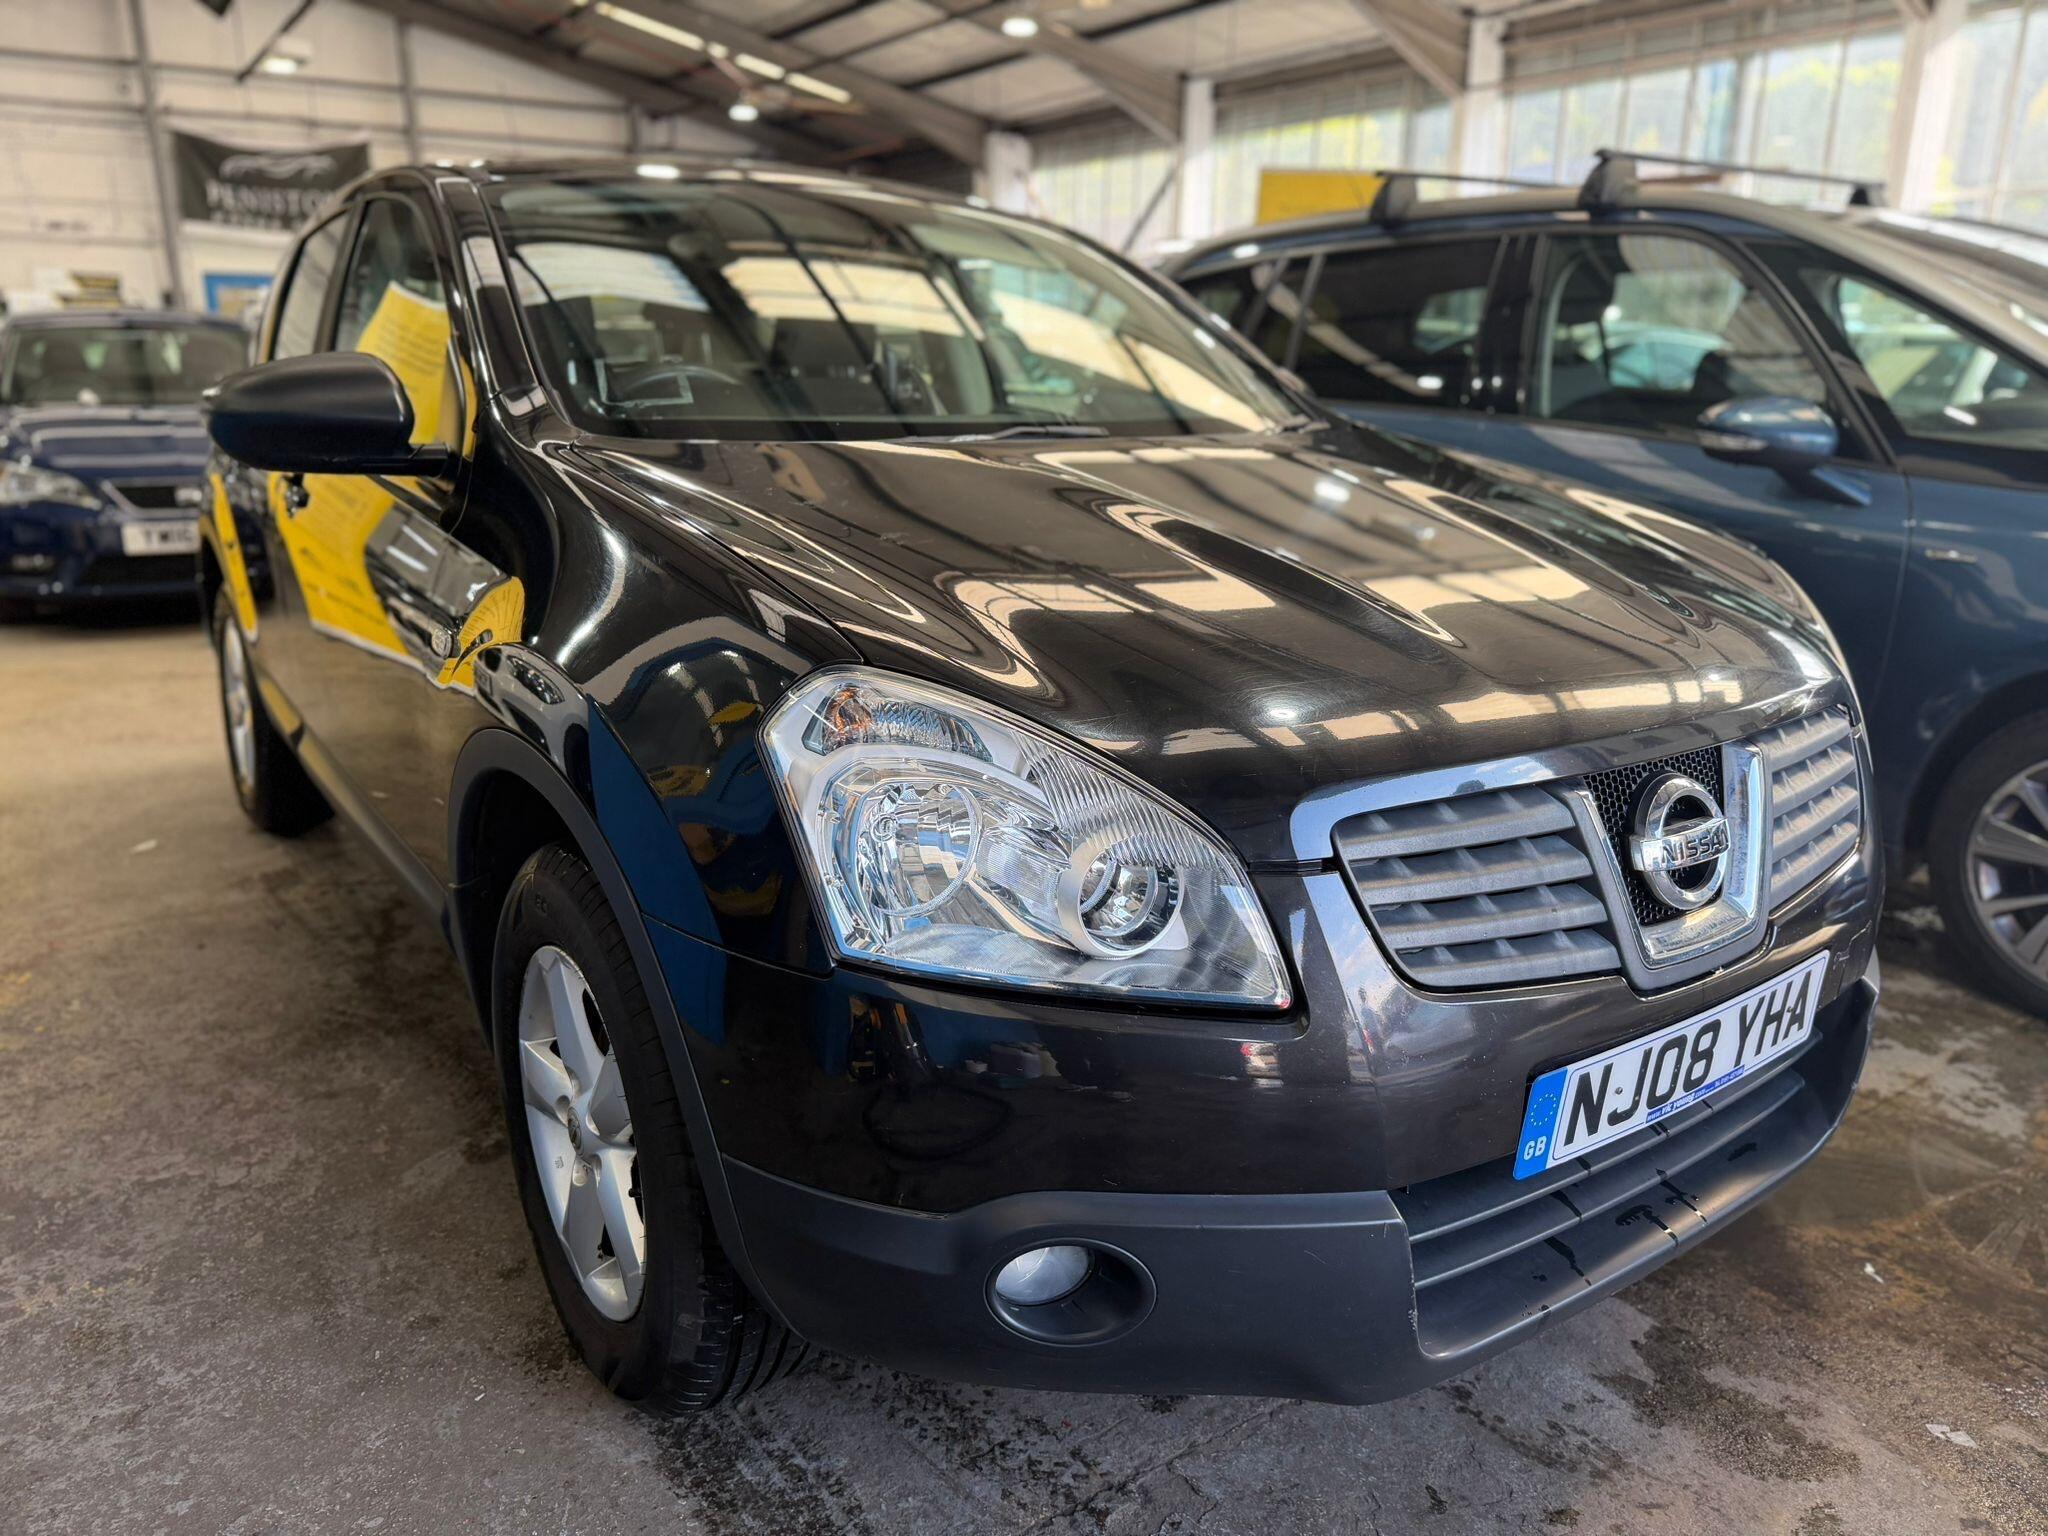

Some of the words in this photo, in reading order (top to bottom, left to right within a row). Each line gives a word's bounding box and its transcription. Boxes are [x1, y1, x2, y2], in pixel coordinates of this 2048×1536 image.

[1563, 1018, 1722, 1147] NJ08
[1733, 969, 1813, 1069] YHA
[1523, 1135, 1547, 1161] GB
